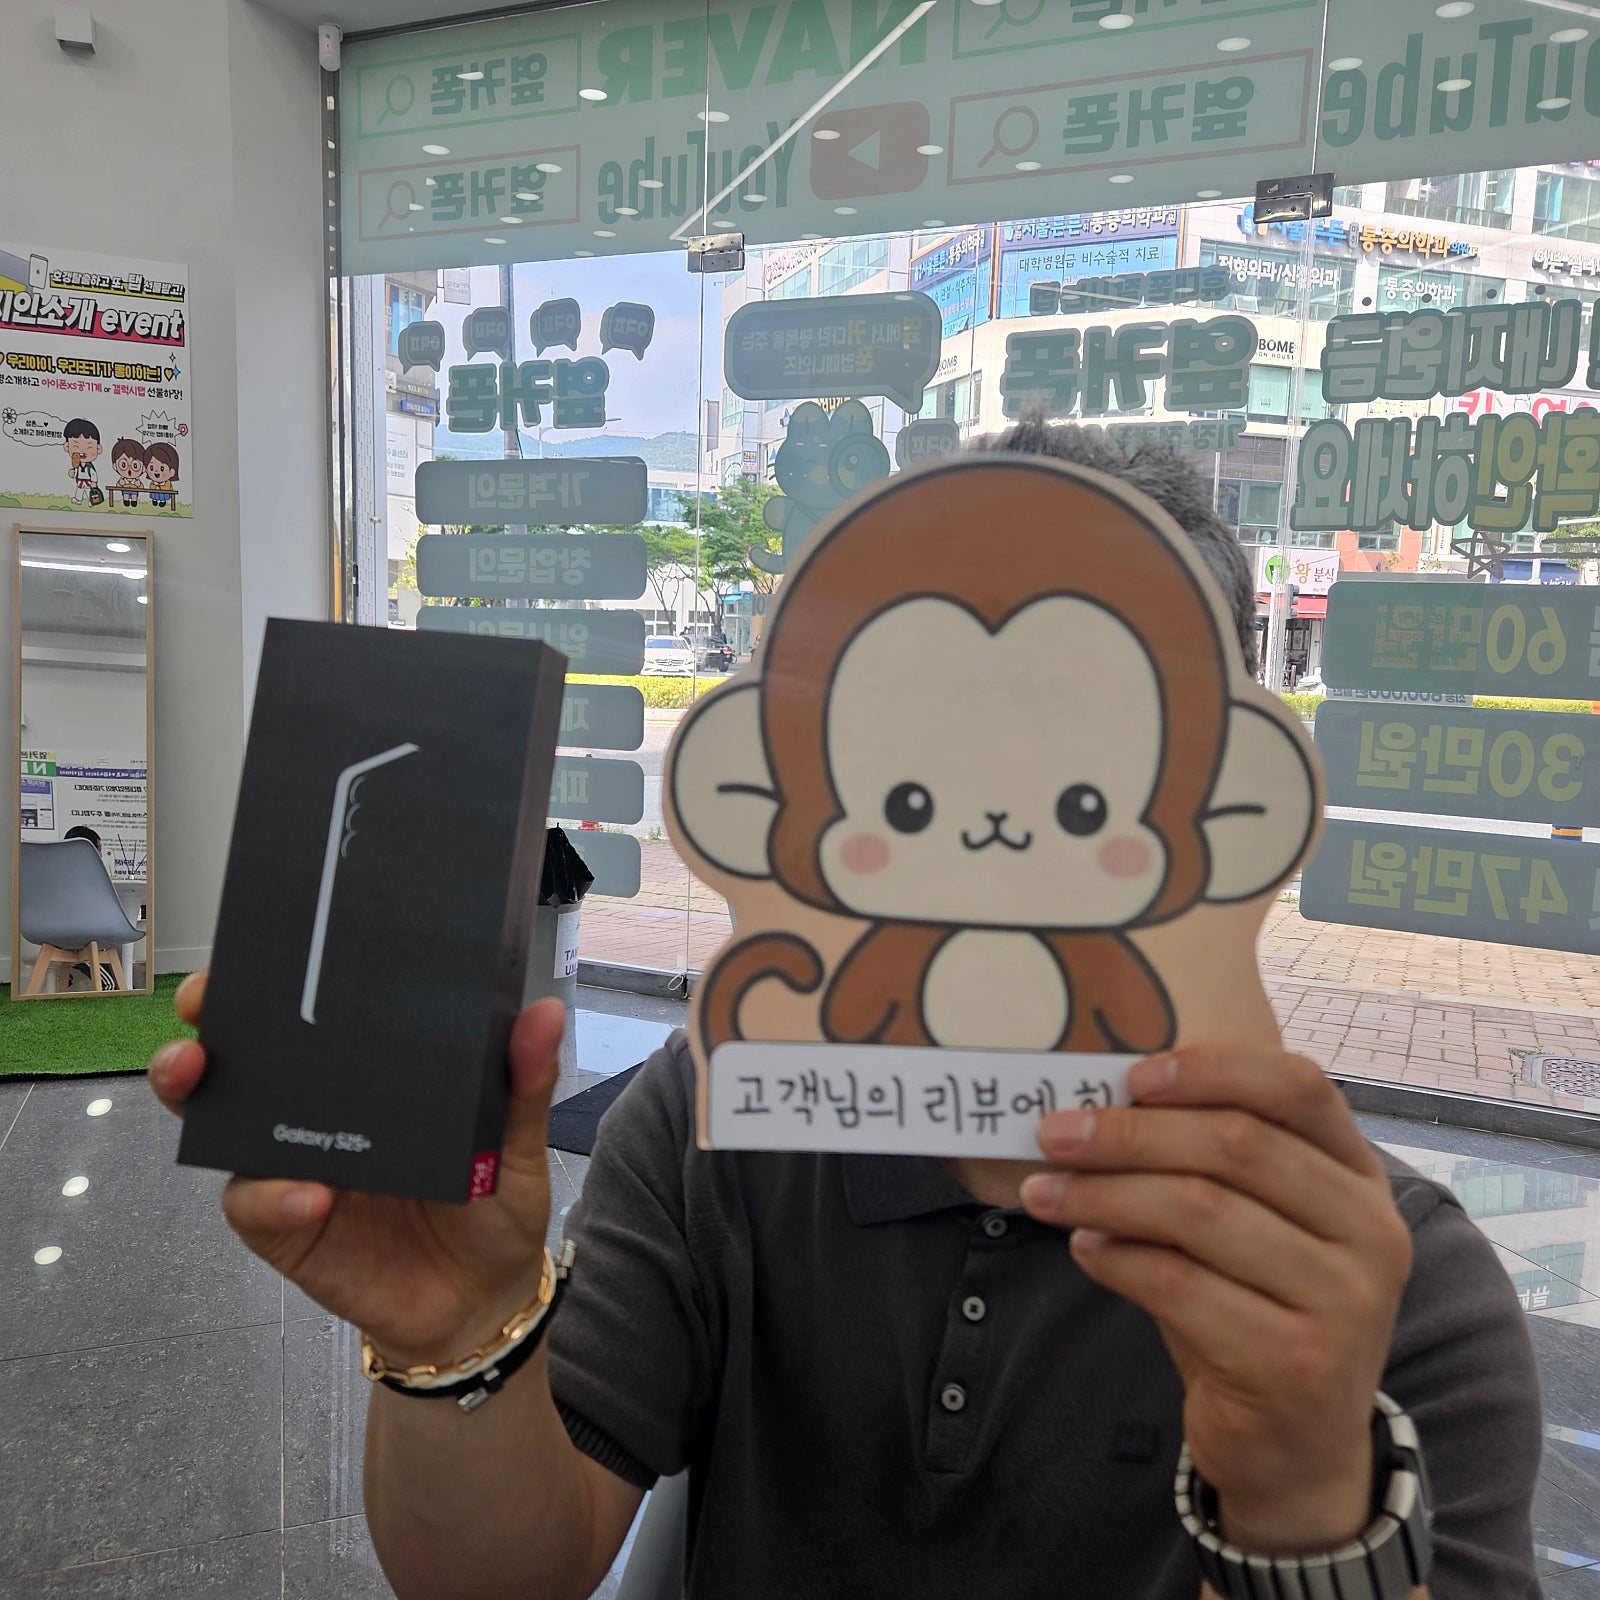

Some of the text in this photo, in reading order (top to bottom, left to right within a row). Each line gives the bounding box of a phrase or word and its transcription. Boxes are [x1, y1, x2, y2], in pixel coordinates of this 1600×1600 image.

[1360, 225, 1450, 260] 통증의학과
[1019, 246, 1160, 273] 대학병원급 비수술적 치료
[1384, 276, 1458, 305] 통증의학과
[100, 308, 182, 340] event
[1313, 567, 1335, 584] 분식
[733, 1067, 905, 1129] 고객님의
[922, 1073, 1057, 1135] 리뷰에
[272, 1122, 335, 1152] Galaxy
